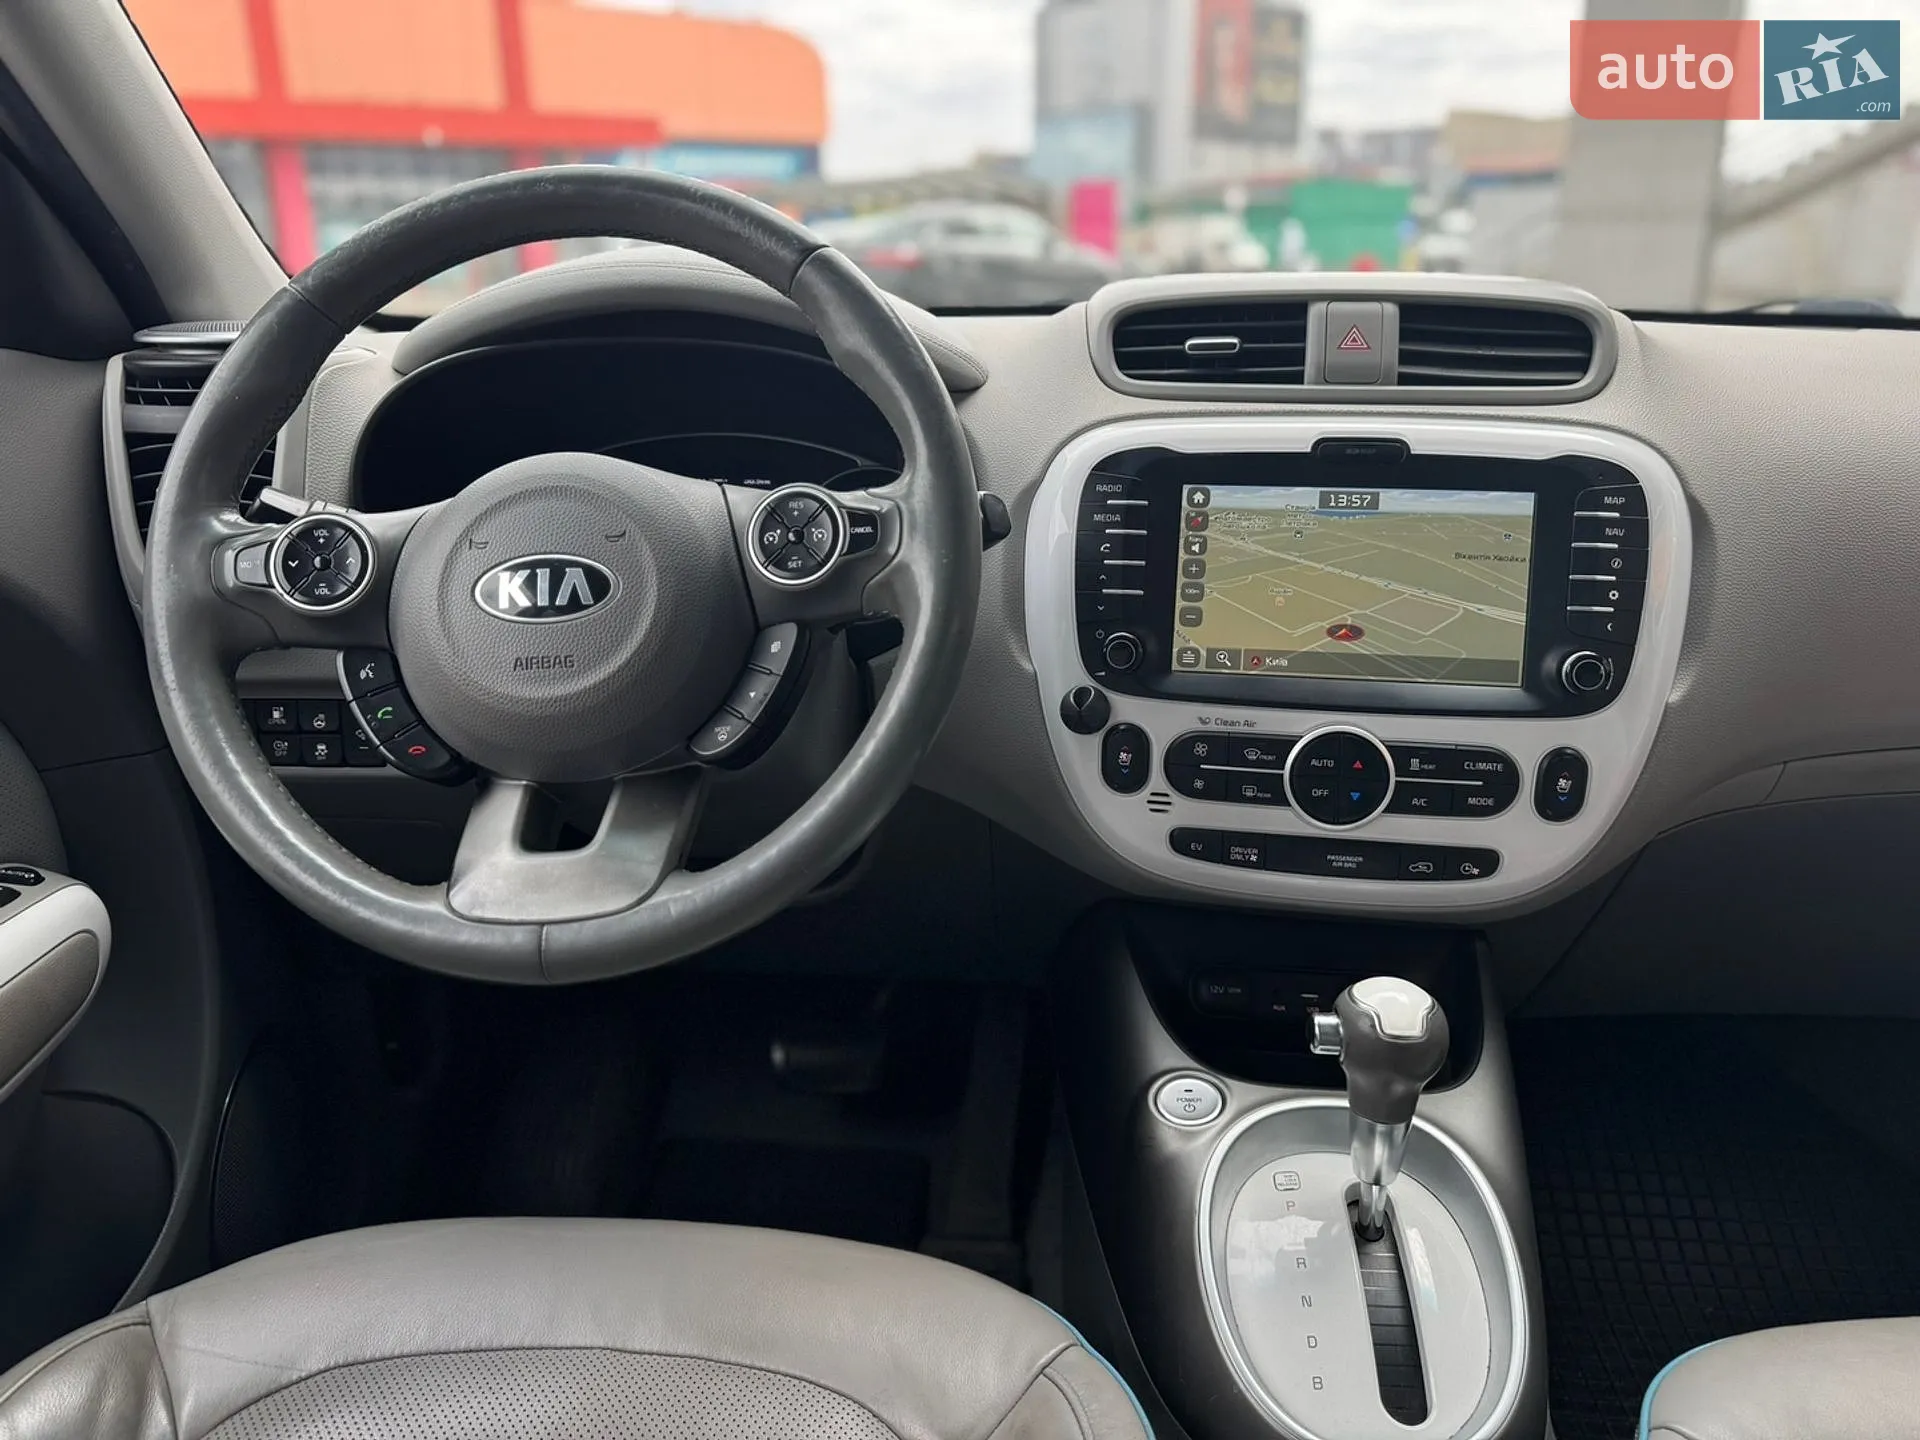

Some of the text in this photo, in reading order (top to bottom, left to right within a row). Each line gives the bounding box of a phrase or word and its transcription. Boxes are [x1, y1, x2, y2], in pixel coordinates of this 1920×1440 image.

[1096, 484, 1123, 492] RADIO
[1329, 494, 1371, 507] 13:57
[1604, 496, 1625, 505] MAP
[1093, 513, 1121, 522] MEDIA
[313, 529, 330, 537] VOL
[1605, 527, 1625, 536] NAV
[787, 560, 803, 569] SET
[314, 588, 331, 596] VOL
[498, 567, 594, 609] KIA
[513, 655, 575, 672] AIRBAG
[1214, 717, 1257, 728] Clean Air
[1310, 758, 1335, 768] AUTO
[1464, 761, 1504, 772] CLIMATE
[1311, 788, 1329, 797] OFF
[1411, 798, 1428, 806] A/C
[1467, 797, 1495, 806] MODE
[1190, 842, 1203, 851] EV
[1230, 846, 1259, 855] DRIVER
[1230, 853, 1249, 861] ONLY
[1285, 1200, 1296, 1211] P
[1296, 1257, 1307, 1268] R
[1301, 1295, 1312, 1307] N
[1307, 1335, 1318, 1348] D
[1312, 1376, 1324, 1390] B
